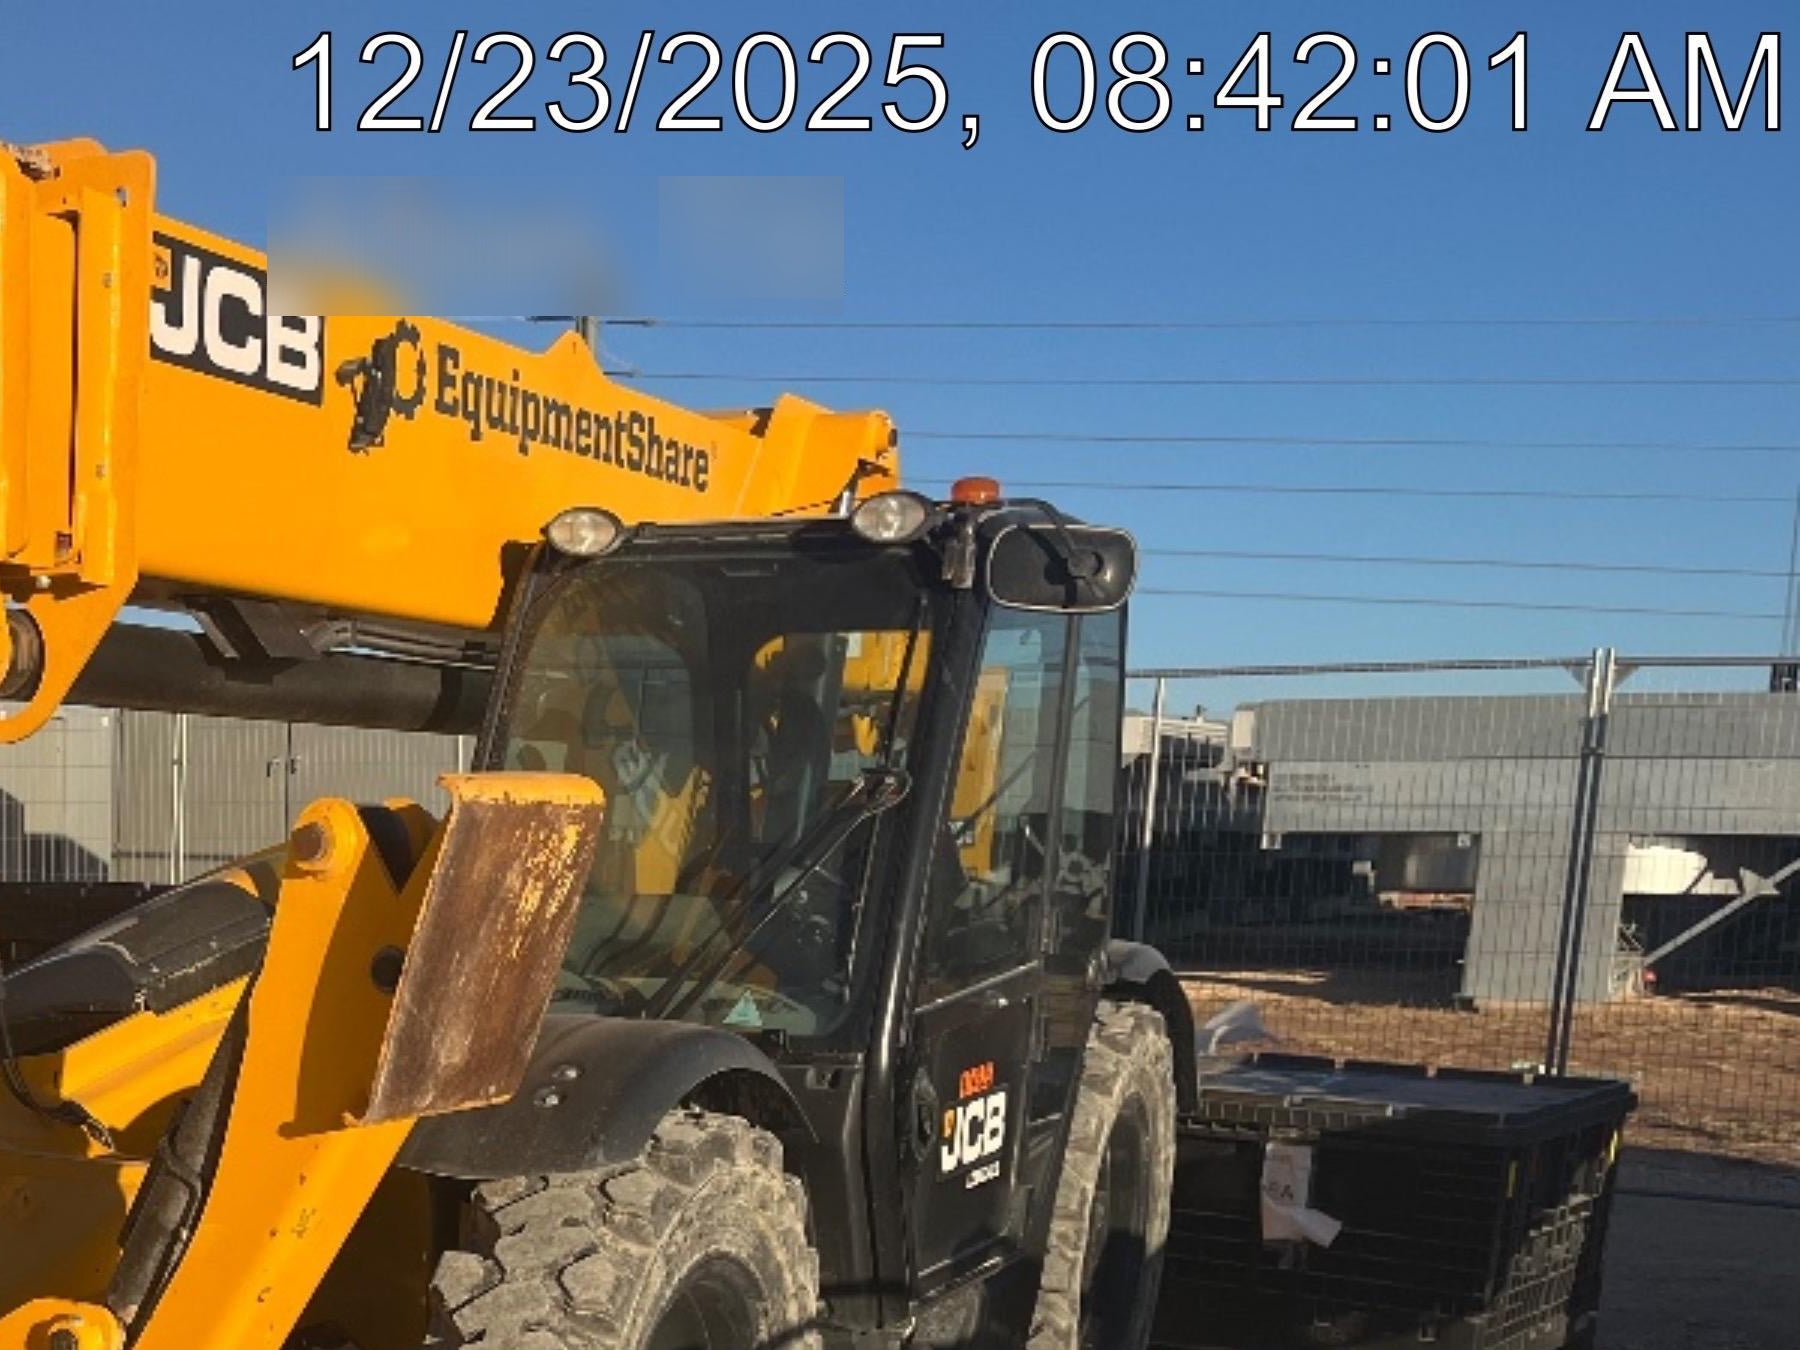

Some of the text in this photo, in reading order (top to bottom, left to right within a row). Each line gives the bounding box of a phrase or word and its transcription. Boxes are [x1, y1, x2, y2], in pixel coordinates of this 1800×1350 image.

[150, 254, 320, 391] JCB
[435, 343, 709, 492] EquipmentShare
[941, 1091, 1006, 1173] JCB
